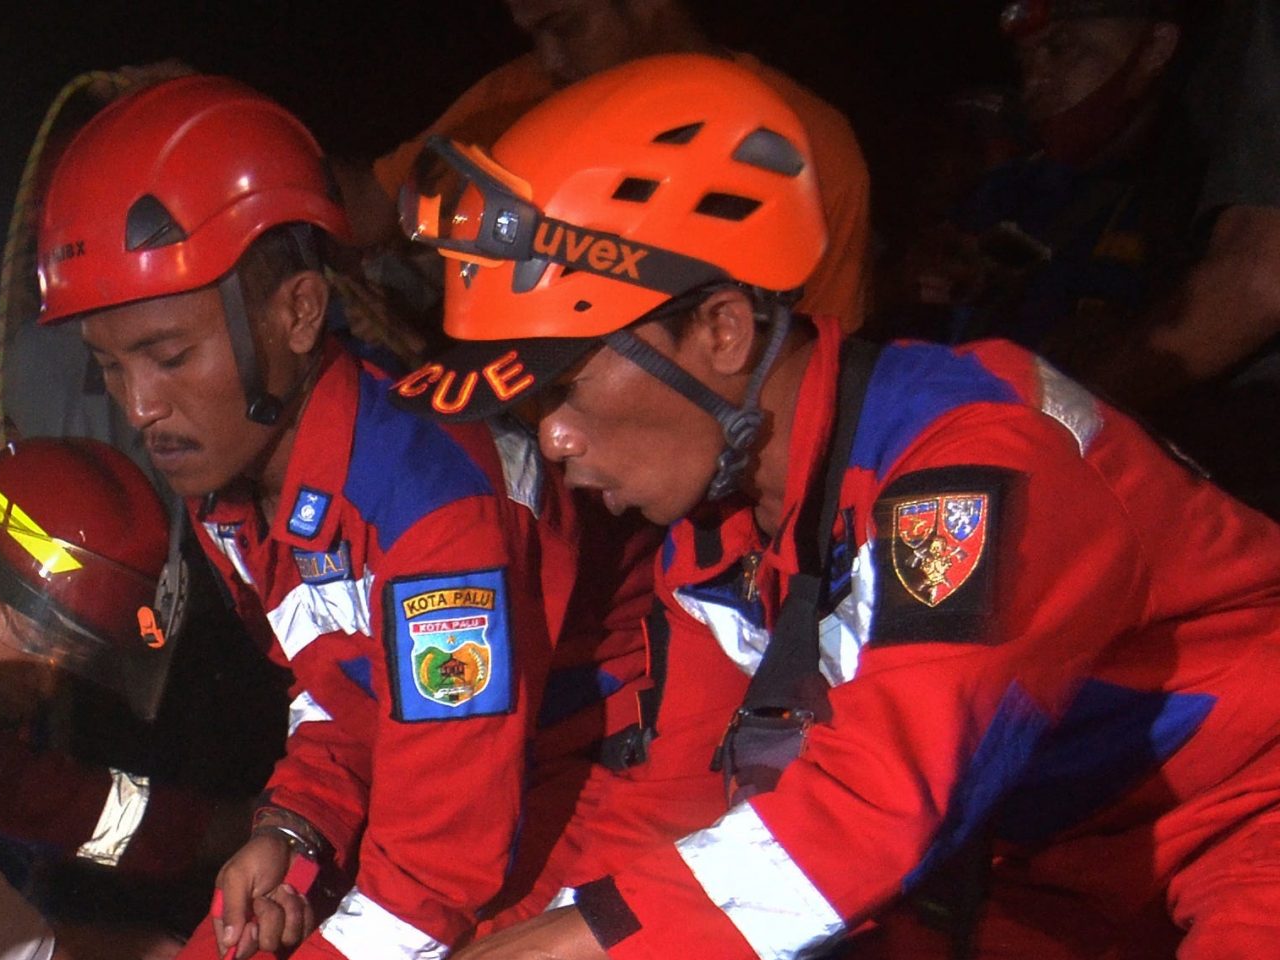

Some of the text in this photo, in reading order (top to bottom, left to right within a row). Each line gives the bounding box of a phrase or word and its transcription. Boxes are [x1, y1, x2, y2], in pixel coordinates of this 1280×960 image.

[533, 221, 651, 280] uvex
[392, 349, 535, 414] CUE
[406, 592, 490, 614] KOTA PALU
[418, 619, 480, 632] KOTA PALU
